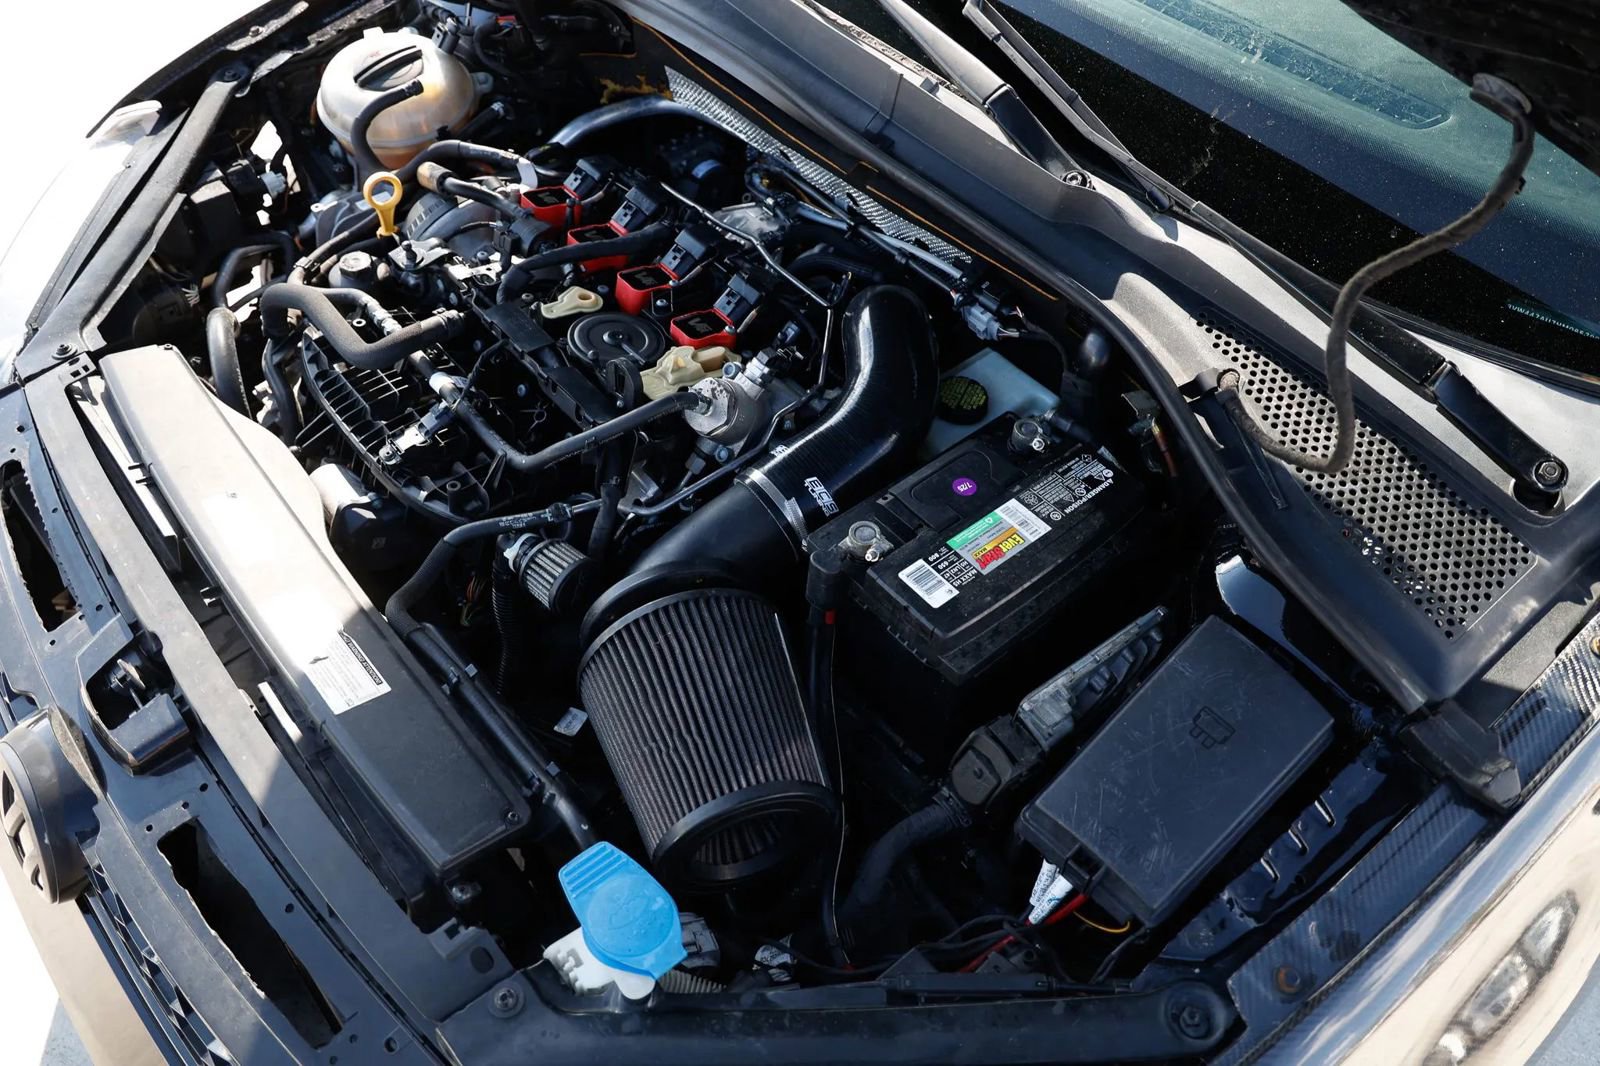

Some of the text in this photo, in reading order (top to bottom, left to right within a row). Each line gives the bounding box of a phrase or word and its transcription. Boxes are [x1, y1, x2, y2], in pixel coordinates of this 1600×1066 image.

[804, 476, 839, 514] ECS
[1063, 480, 1110, 514] DANGER/POISON
[976, 532, 1026, 570] EverStart
[960, 568, 978, 582] MAXX
